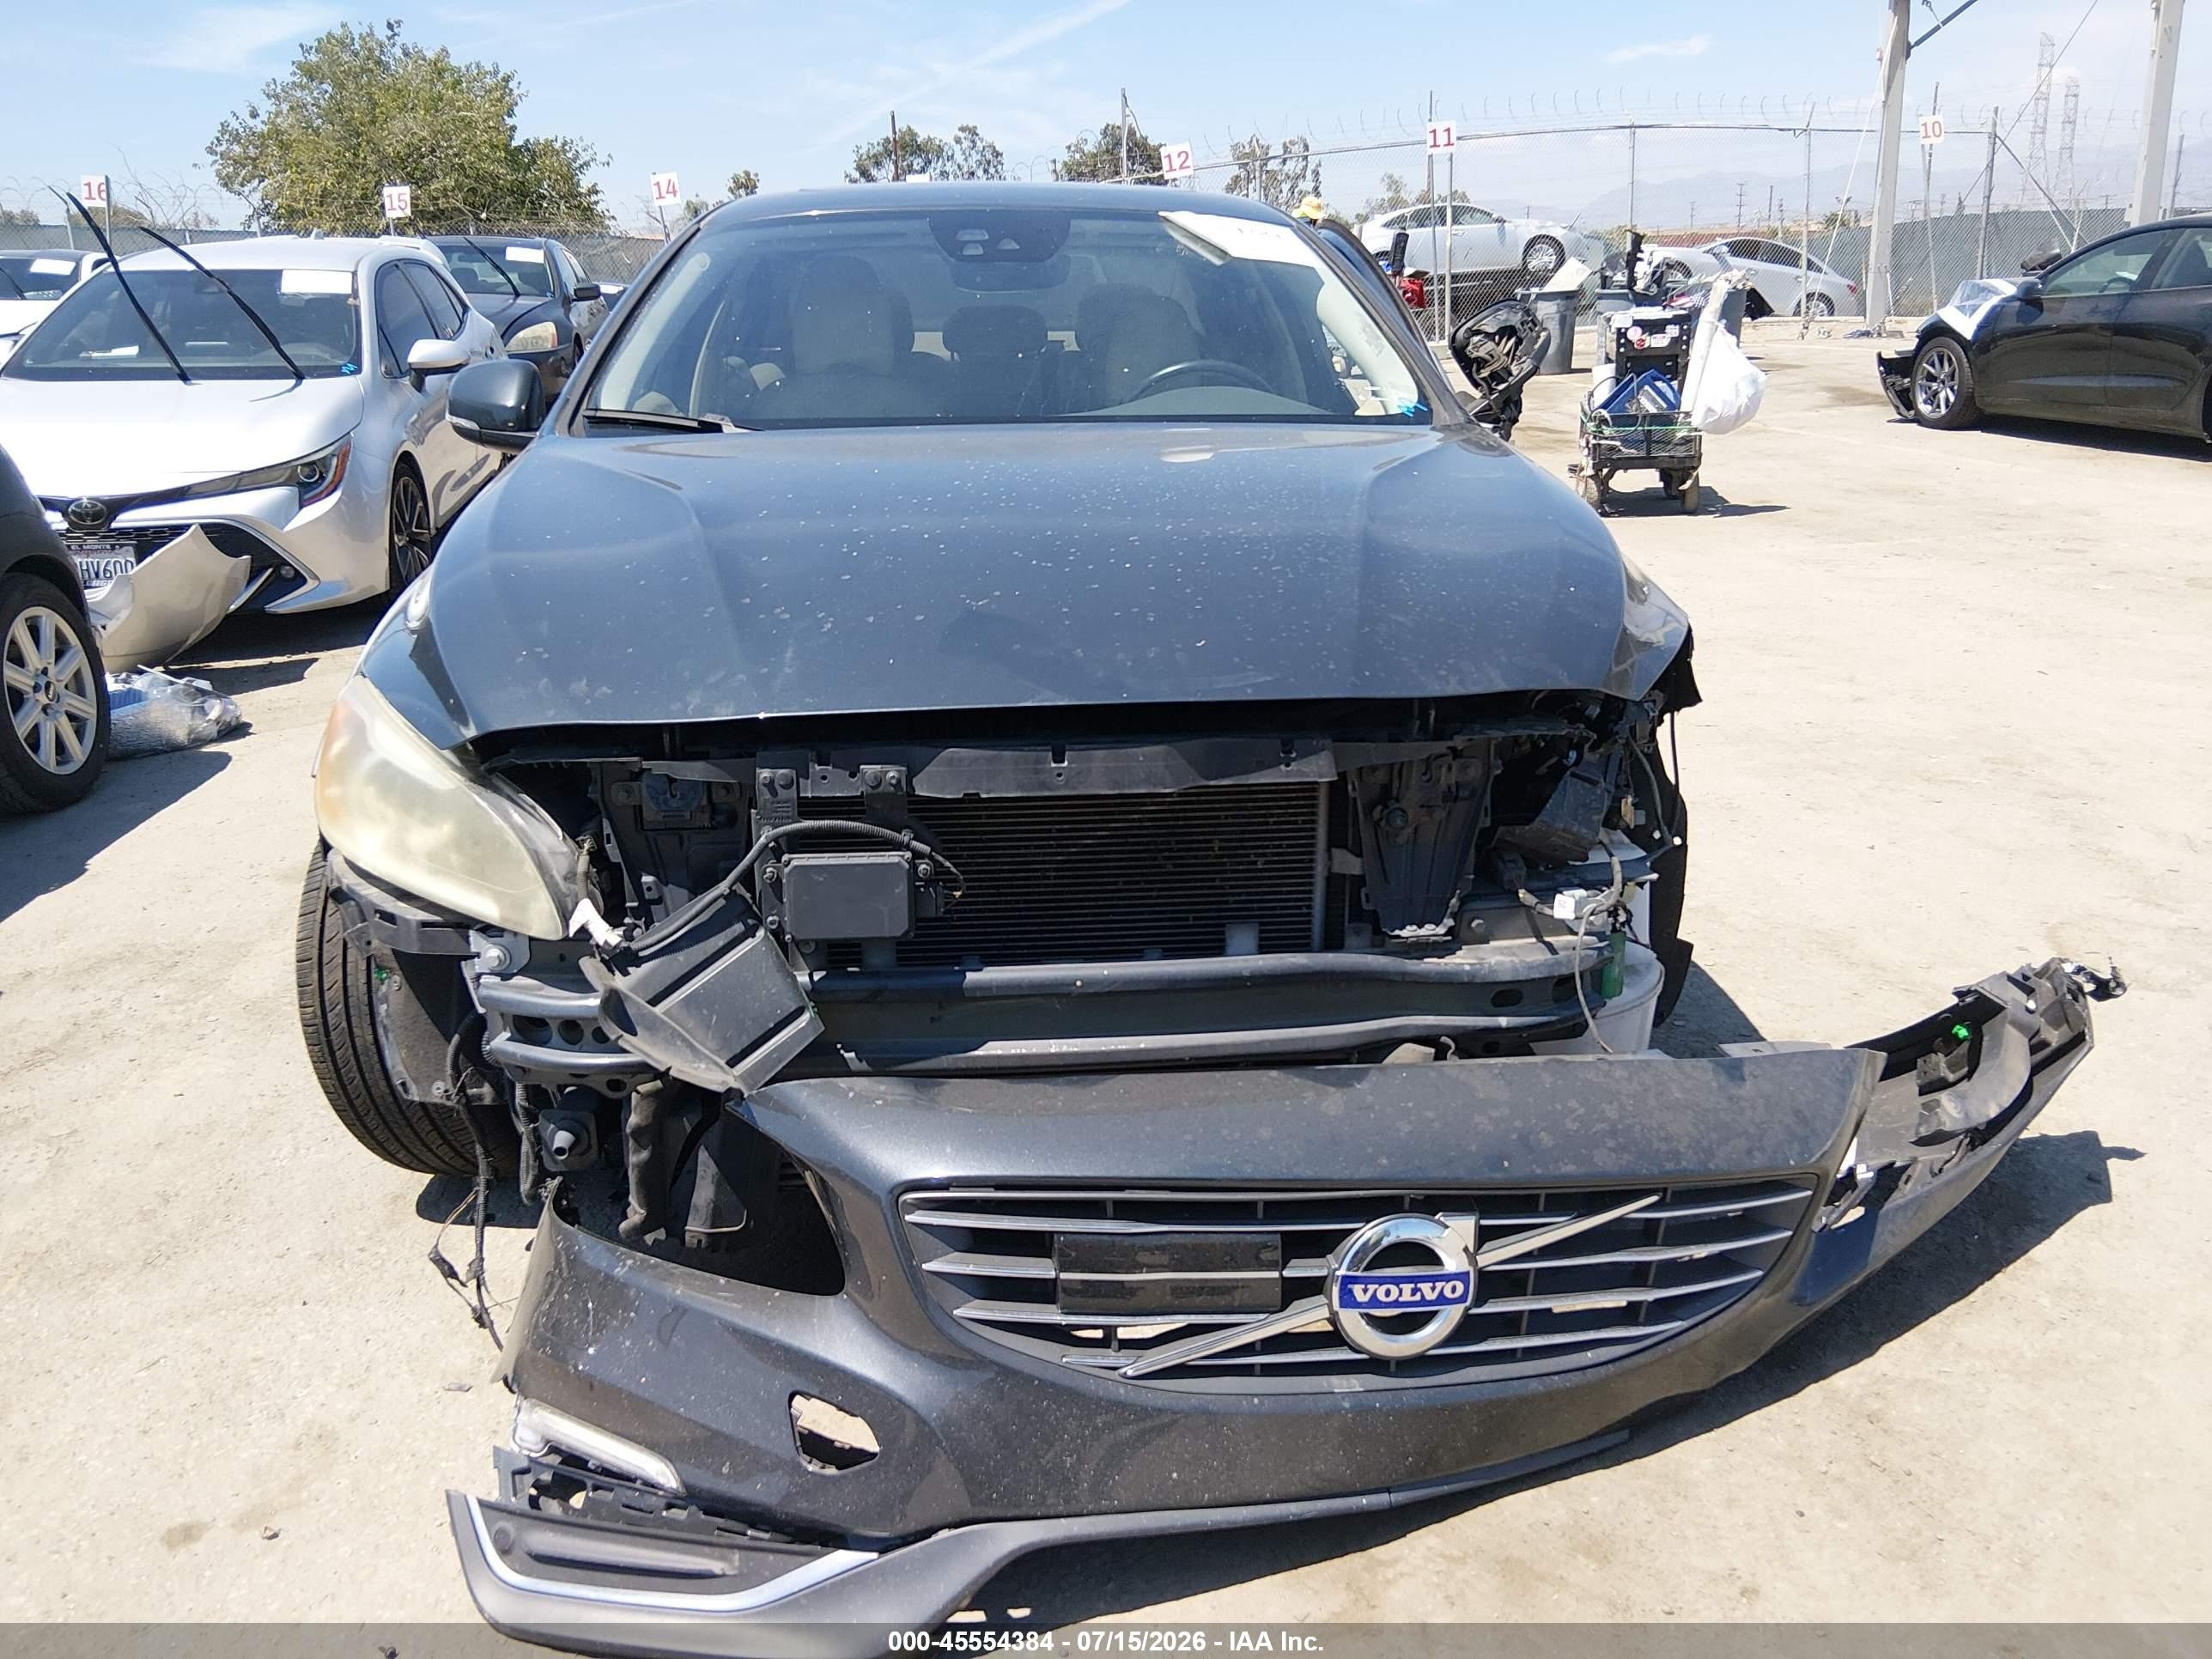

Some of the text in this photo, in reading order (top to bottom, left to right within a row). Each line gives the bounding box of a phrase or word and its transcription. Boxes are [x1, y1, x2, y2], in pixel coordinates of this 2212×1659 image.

[1428, 127, 1455, 149] 11
[1921, 120, 1942, 138] 10
[1164, 150, 1191, 173] 12
[83, 181, 106, 202] 16
[653, 179, 678, 199] 14
[386, 192, 408, 211] 15
[78, 559, 135, 580] HV600
[1347, 1279, 1465, 1304] VOLVO
